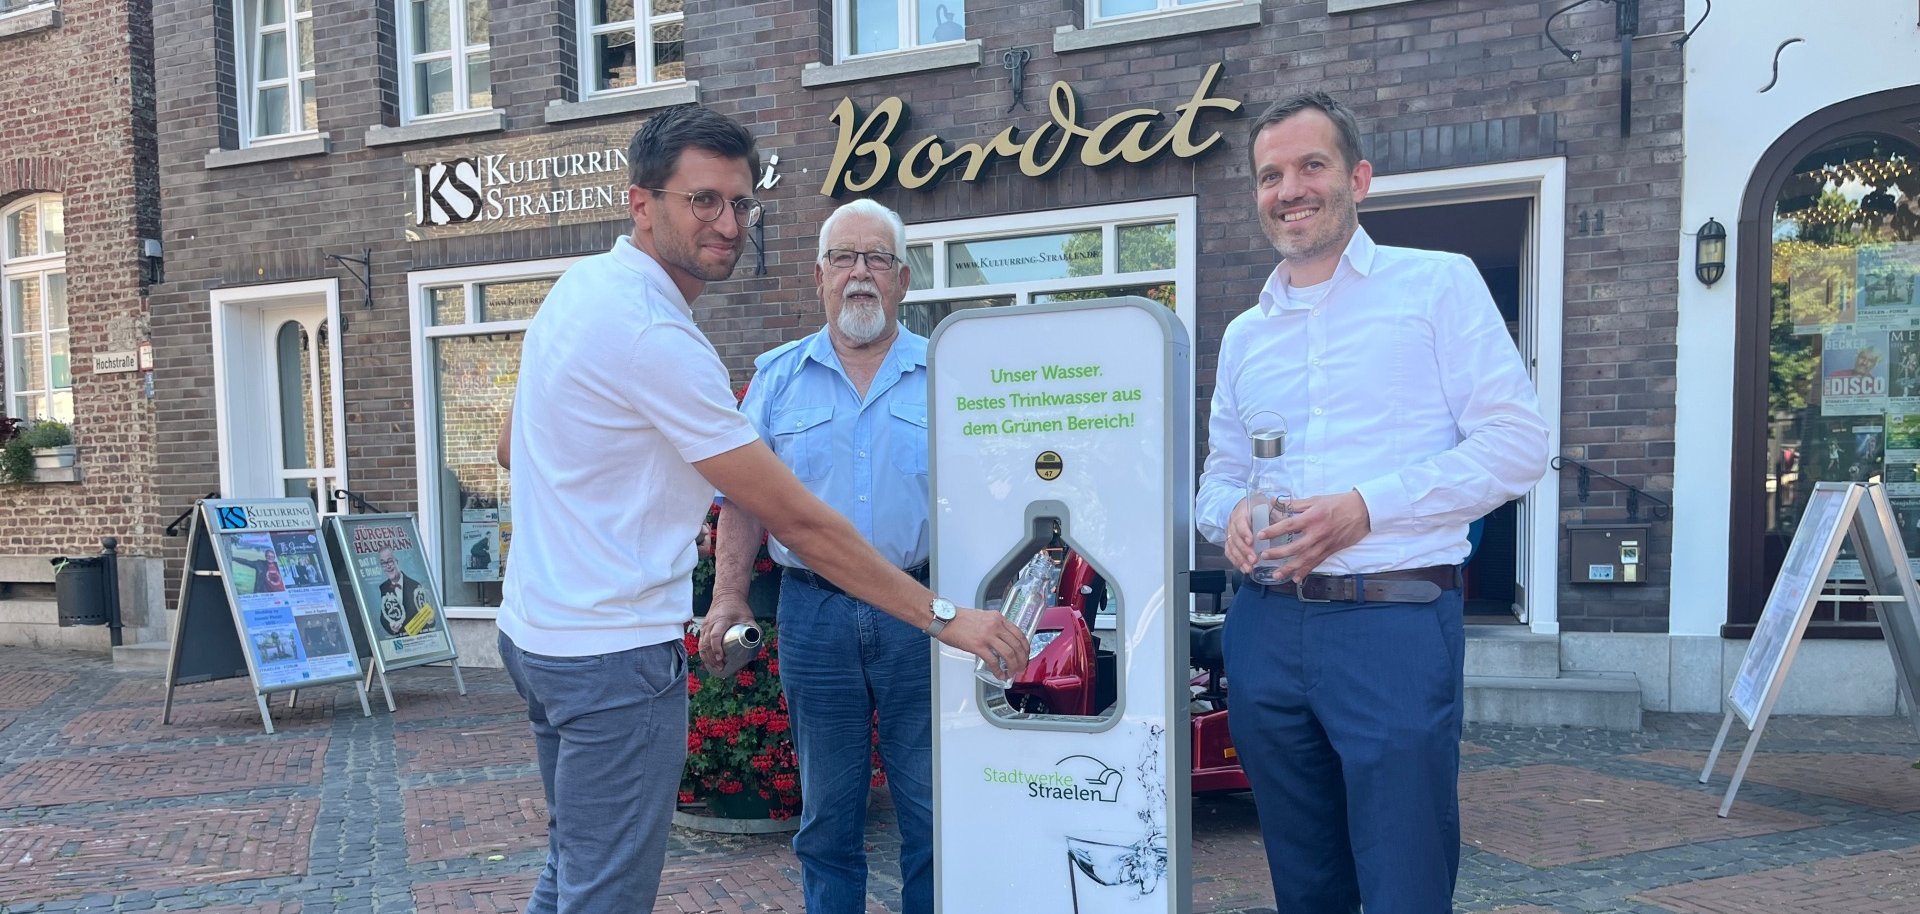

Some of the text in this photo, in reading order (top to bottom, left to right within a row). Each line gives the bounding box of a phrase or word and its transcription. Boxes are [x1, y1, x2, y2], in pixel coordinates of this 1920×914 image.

[819, 62, 1242, 197] Bordat
[484, 148, 629, 187] KULTURRIN
[415, 157, 482, 226] KS
[486, 185, 614, 220] STRAELEN
[1578, 209, 1604, 232] 11
[1824, 339, 1867, 350] BECKER
[96, 355, 135, 370] Hochstraße
[991, 364, 1103, 384] Unser Wasser.
[1831, 376, 1886, 395] DISCO
[957, 388, 1142, 411] Bestes Trinkwasser aus
[962, 412, 1135, 436] dem Grünen Bereich!
[216, 506, 248, 529] KS
[246, 506, 310, 518] KULTURRING
[250, 518, 300, 529] STRAELEN
[354, 525, 408, 541] JÜRGEN B.
[354, 538, 412, 554] HAUSMANN
[983, 767, 1073, 787] Stadtwerke
[1028, 781, 1102, 801] Straelen
